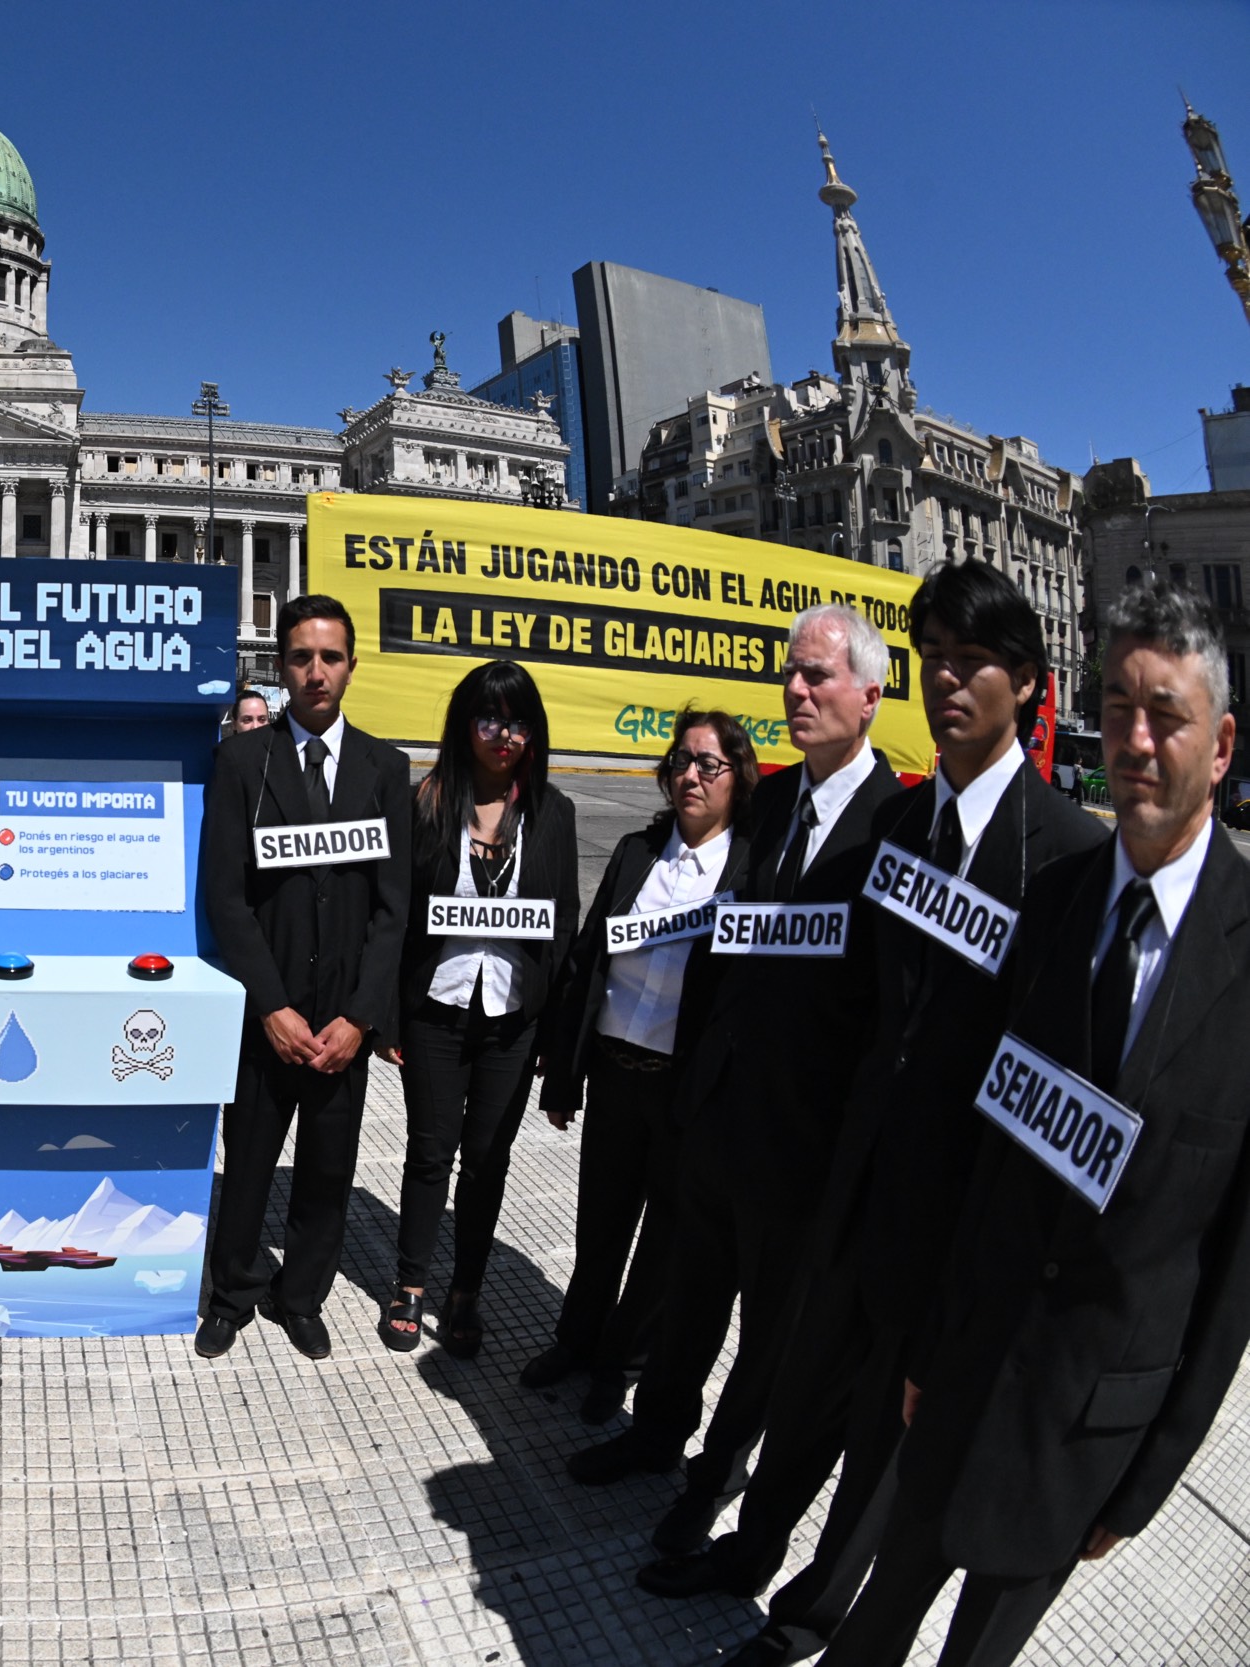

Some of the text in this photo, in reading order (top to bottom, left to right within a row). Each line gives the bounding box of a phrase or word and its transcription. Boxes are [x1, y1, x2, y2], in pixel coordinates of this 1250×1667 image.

[344, 529, 467, 575] ESTÁN
[480, 544, 641, 592] JUGANDO
[652, 562, 711, 601] CON
[721, 571, 754, 607] EL
[759, 577, 822, 614] AGUA
[861, 595, 911, 634] TODO
[36, 582, 202, 625] FUTURO
[76, 631, 191, 672] AGUA
[411, 605, 458, 644] LA
[471, 609, 537, 649] LEY
[549, 614, 593, 655] DE
[604, 620, 765, 673] GLACIARES
[614, 704, 790, 746] GREACE
[6, 790, 156, 810] TU VOTO IMPORTA
[19, 830, 161, 844] Ponés en riesgo el agua de
[19, 844, 95, 856] los argentinos
[260, 826, 384, 860] SENADOR
[20, 868, 149, 880] Protegés a los glaciares
[431, 904, 552, 931] SENADORA
[610, 899, 729, 945] SENADOR
[872, 853, 1010, 961] SENADOR
[717, 913, 845, 947] SENADOR
[986, 1051, 1125, 1189] SENADOR
